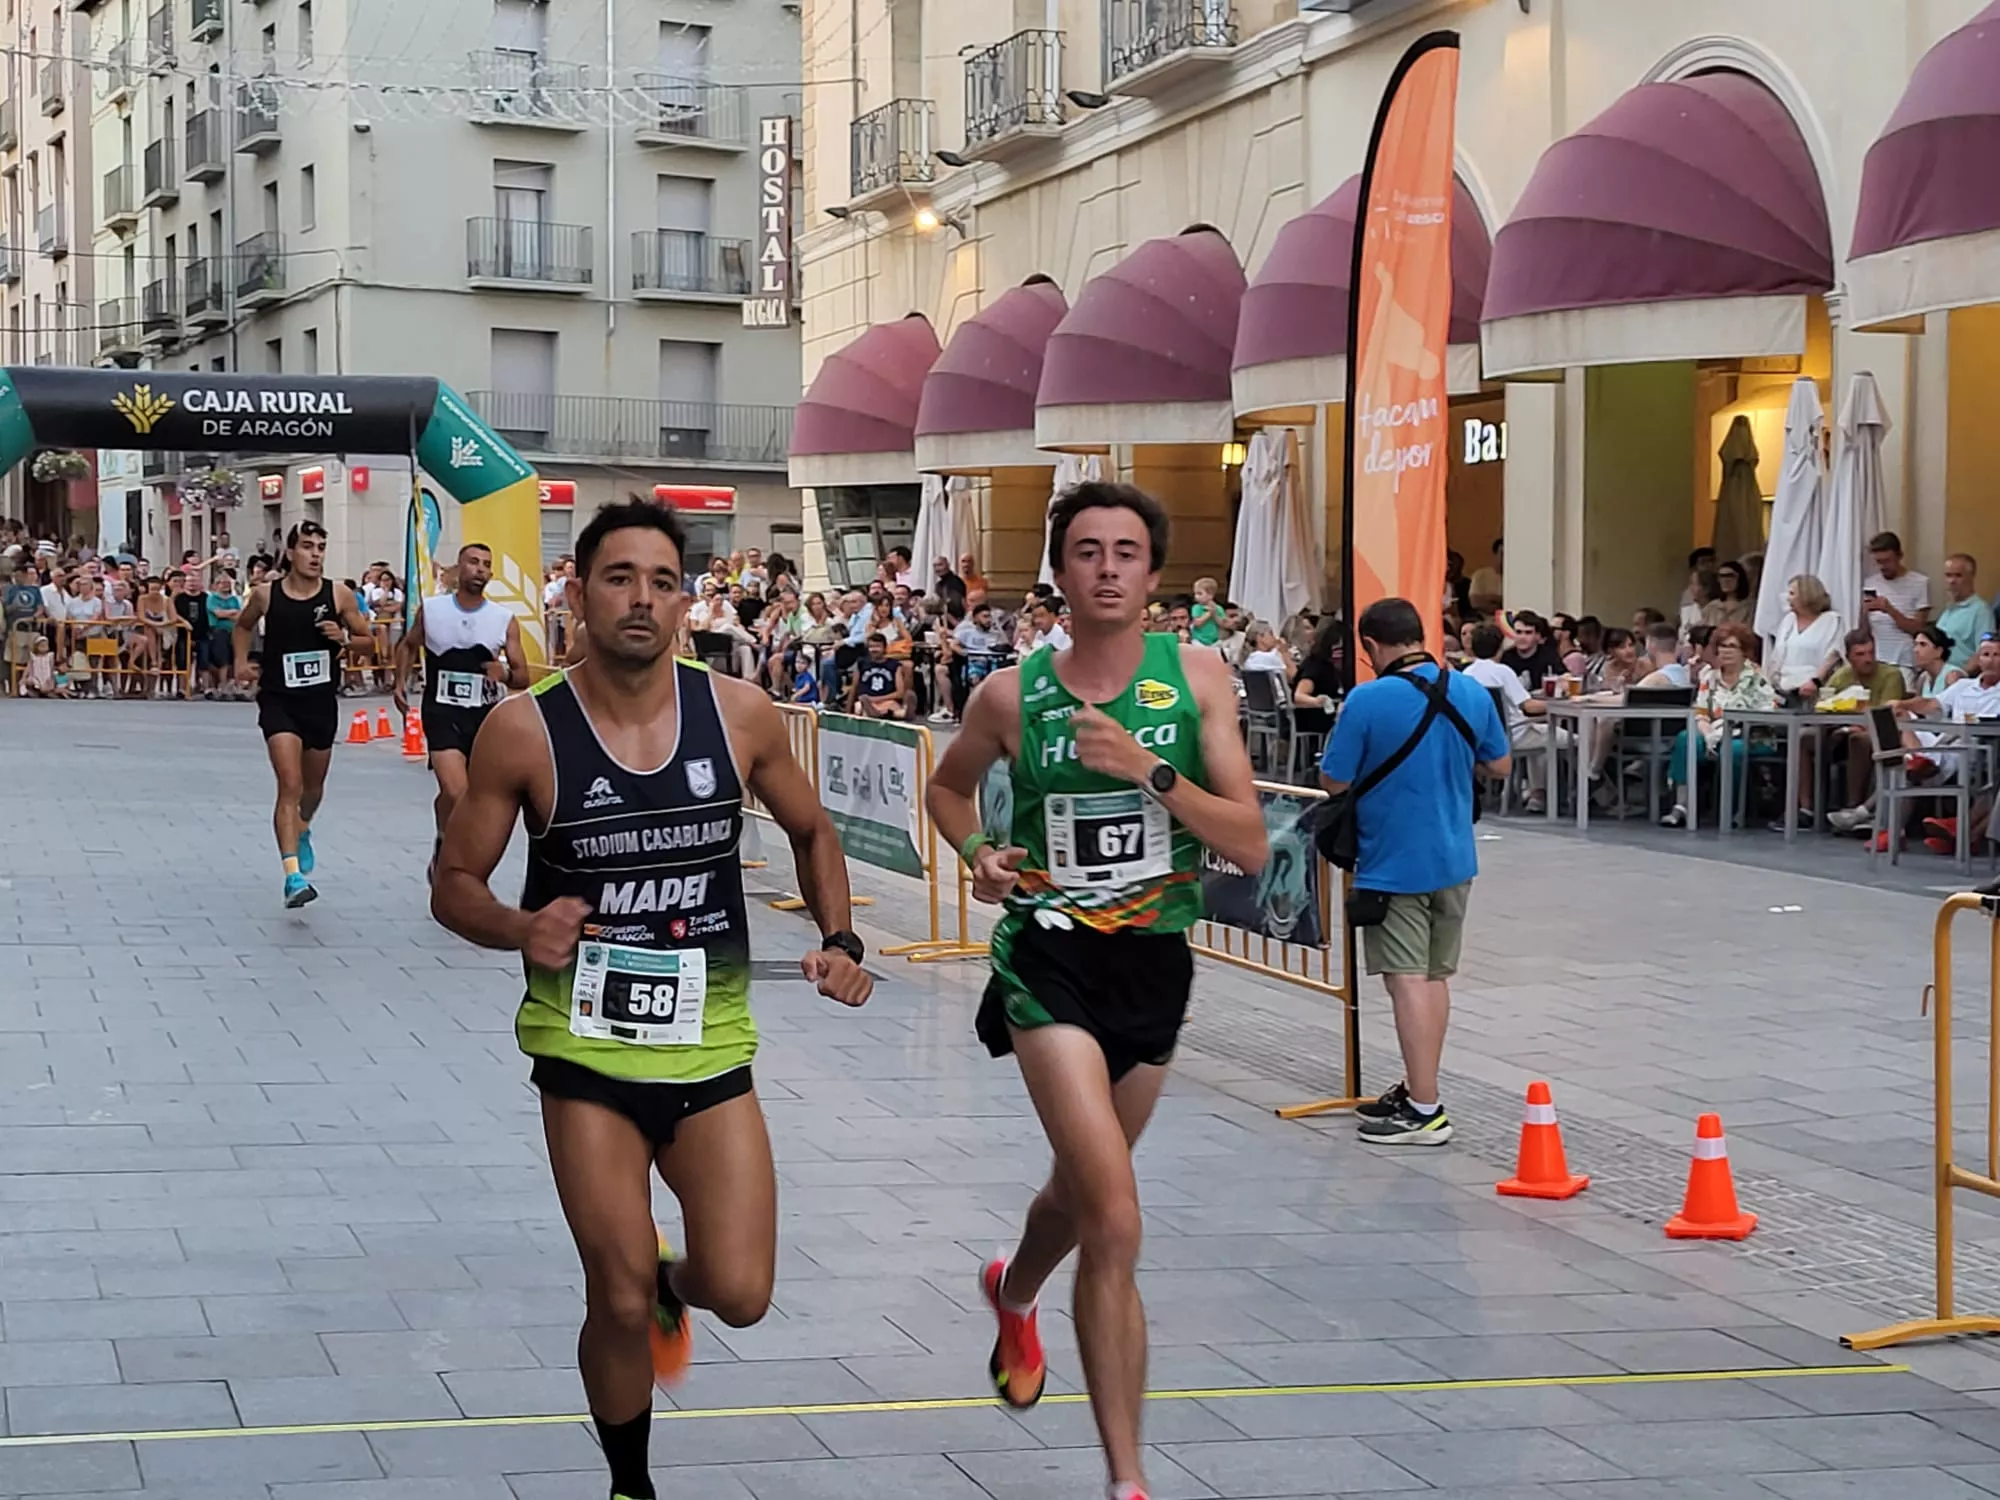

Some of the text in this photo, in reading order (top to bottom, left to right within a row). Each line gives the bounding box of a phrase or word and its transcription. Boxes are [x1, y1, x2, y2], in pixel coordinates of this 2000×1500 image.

[760, 118, 787, 292] HOSTAL
[182, 389, 353, 414] CAJA RURAL
[203, 417, 333, 437] DE ARAGÓN
[303, 663, 319, 676] 64
[1041, 723, 1178, 768] Huca
[571, 830, 640, 859] STADIUM
[1098, 823, 1142, 857] 67
[600, 872, 709, 915] MAPEI
[628, 982, 675, 1017] 58
